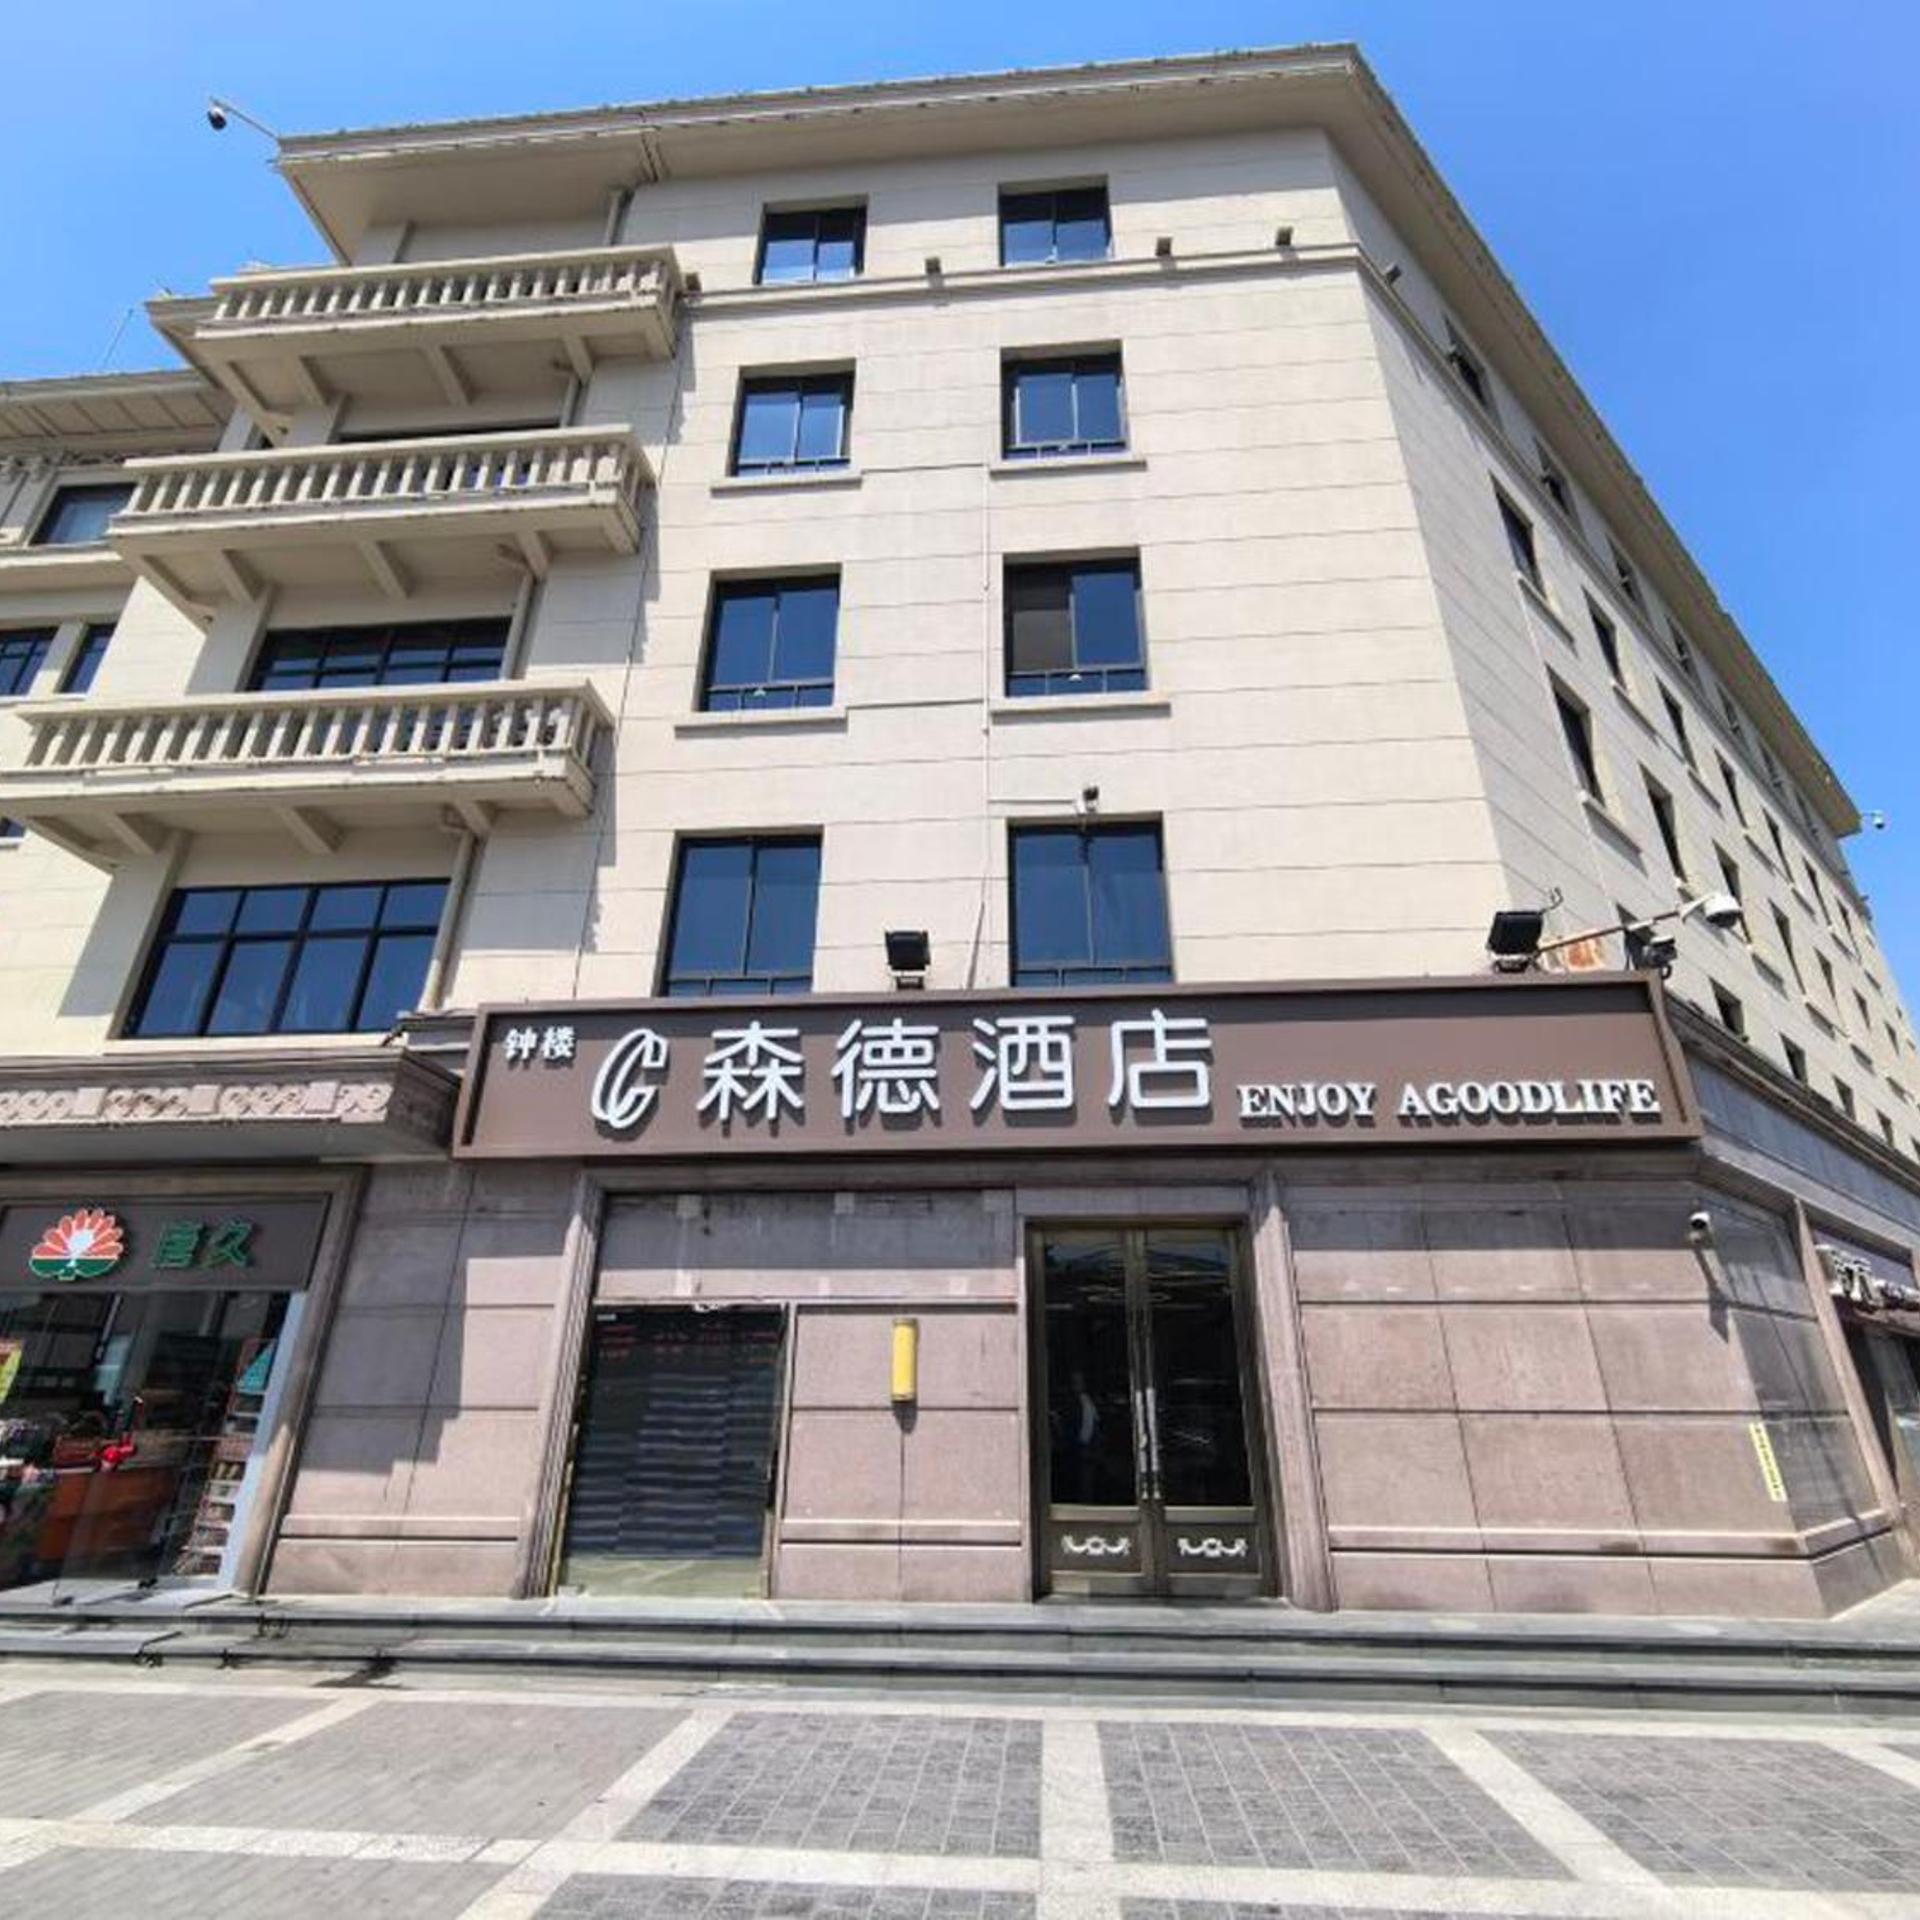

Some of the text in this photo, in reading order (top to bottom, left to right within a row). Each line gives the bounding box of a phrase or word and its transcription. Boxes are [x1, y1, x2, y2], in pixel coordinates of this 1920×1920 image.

[503, 1025, 576, 1061] 钟楼
[696, 1008, 1213, 1120] 森德酒店
[1237, 1078, 1661, 1118] ENJOY AGOODLIFE
